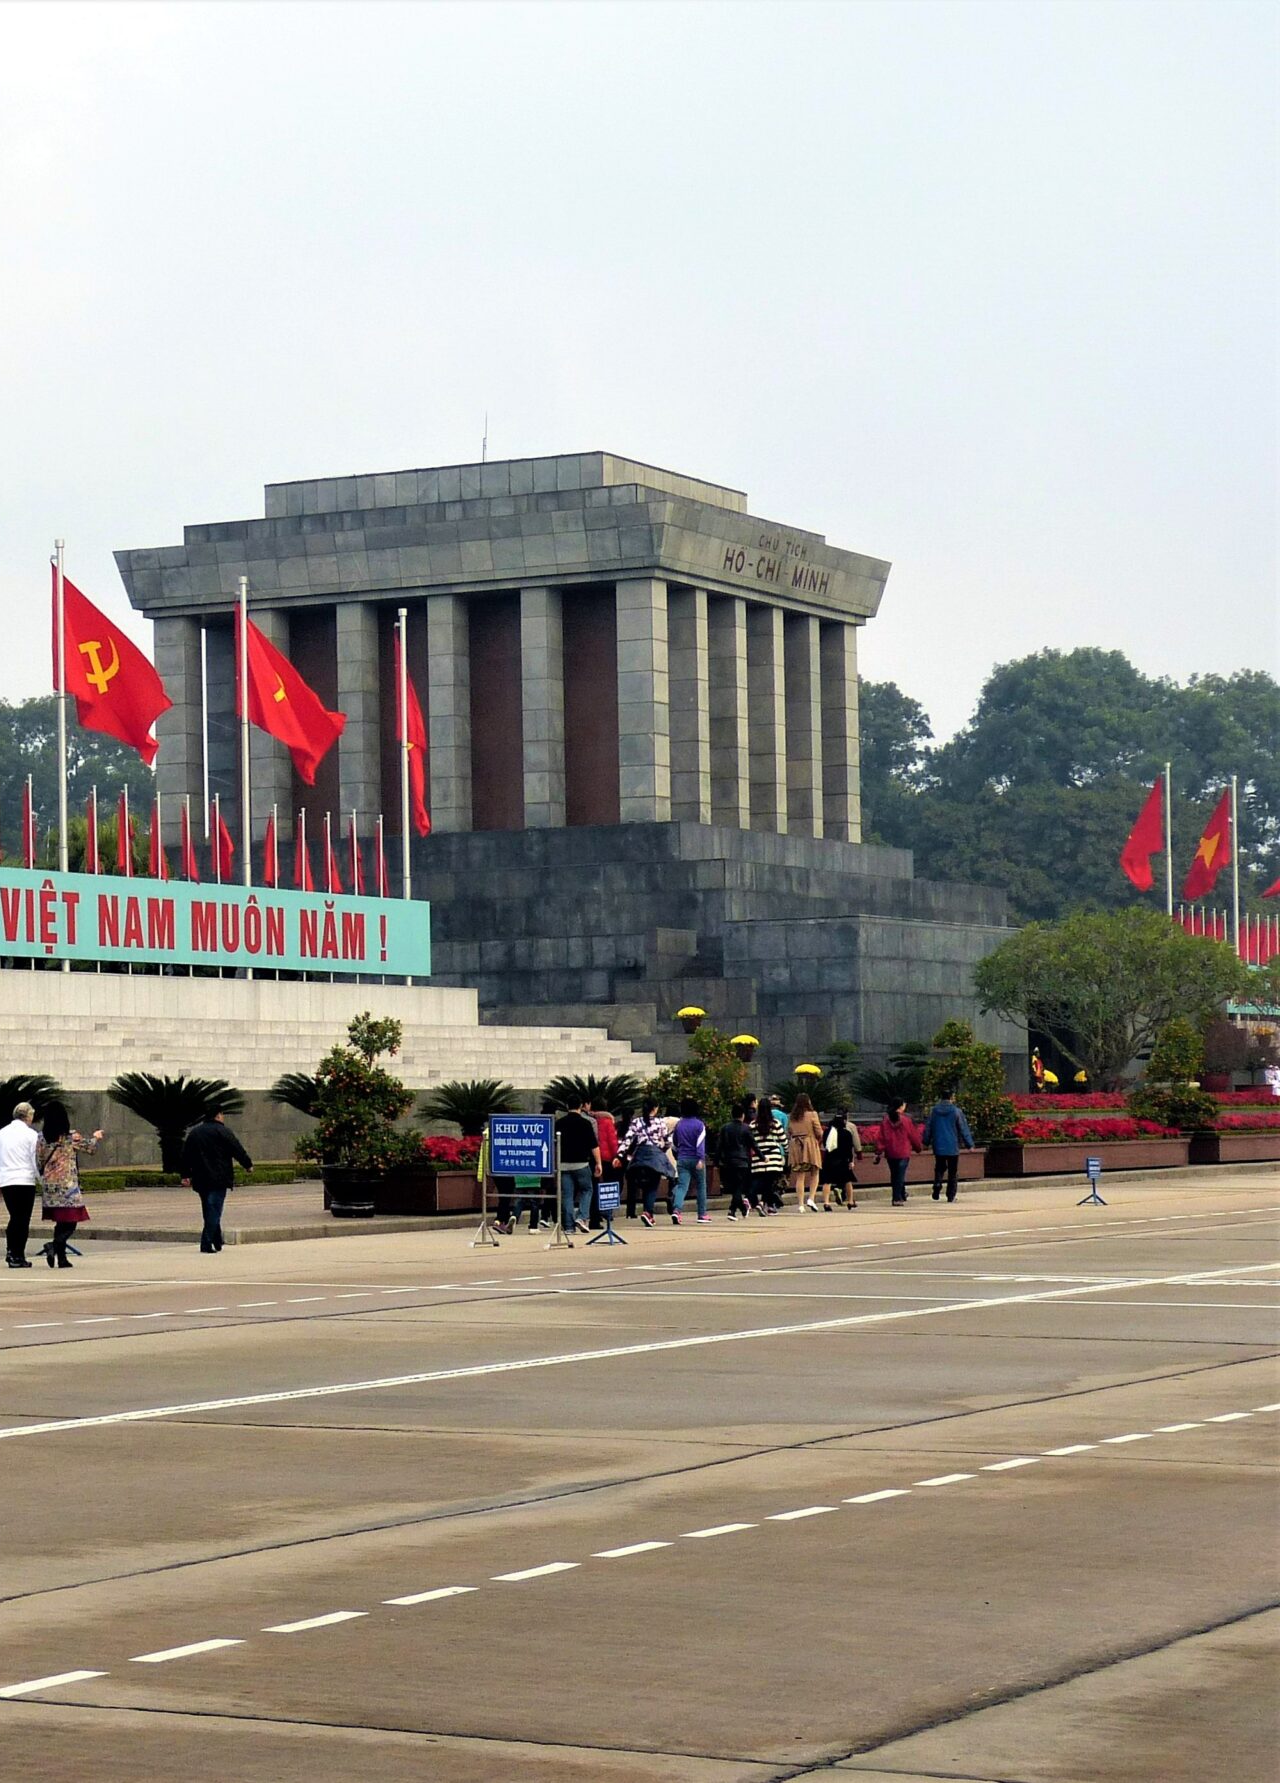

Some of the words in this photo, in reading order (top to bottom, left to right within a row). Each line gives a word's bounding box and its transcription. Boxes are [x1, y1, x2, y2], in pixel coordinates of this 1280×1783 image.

[1, 879, 80, 954] VIỆT
[98, 895, 175, 949] NAM
[191, 893, 285, 956] MUÔN
[300, 900, 366, 960] NĂM
[495, 1123, 519, 1134] KHU
[522, 1123, 544, 1136] VỰC
